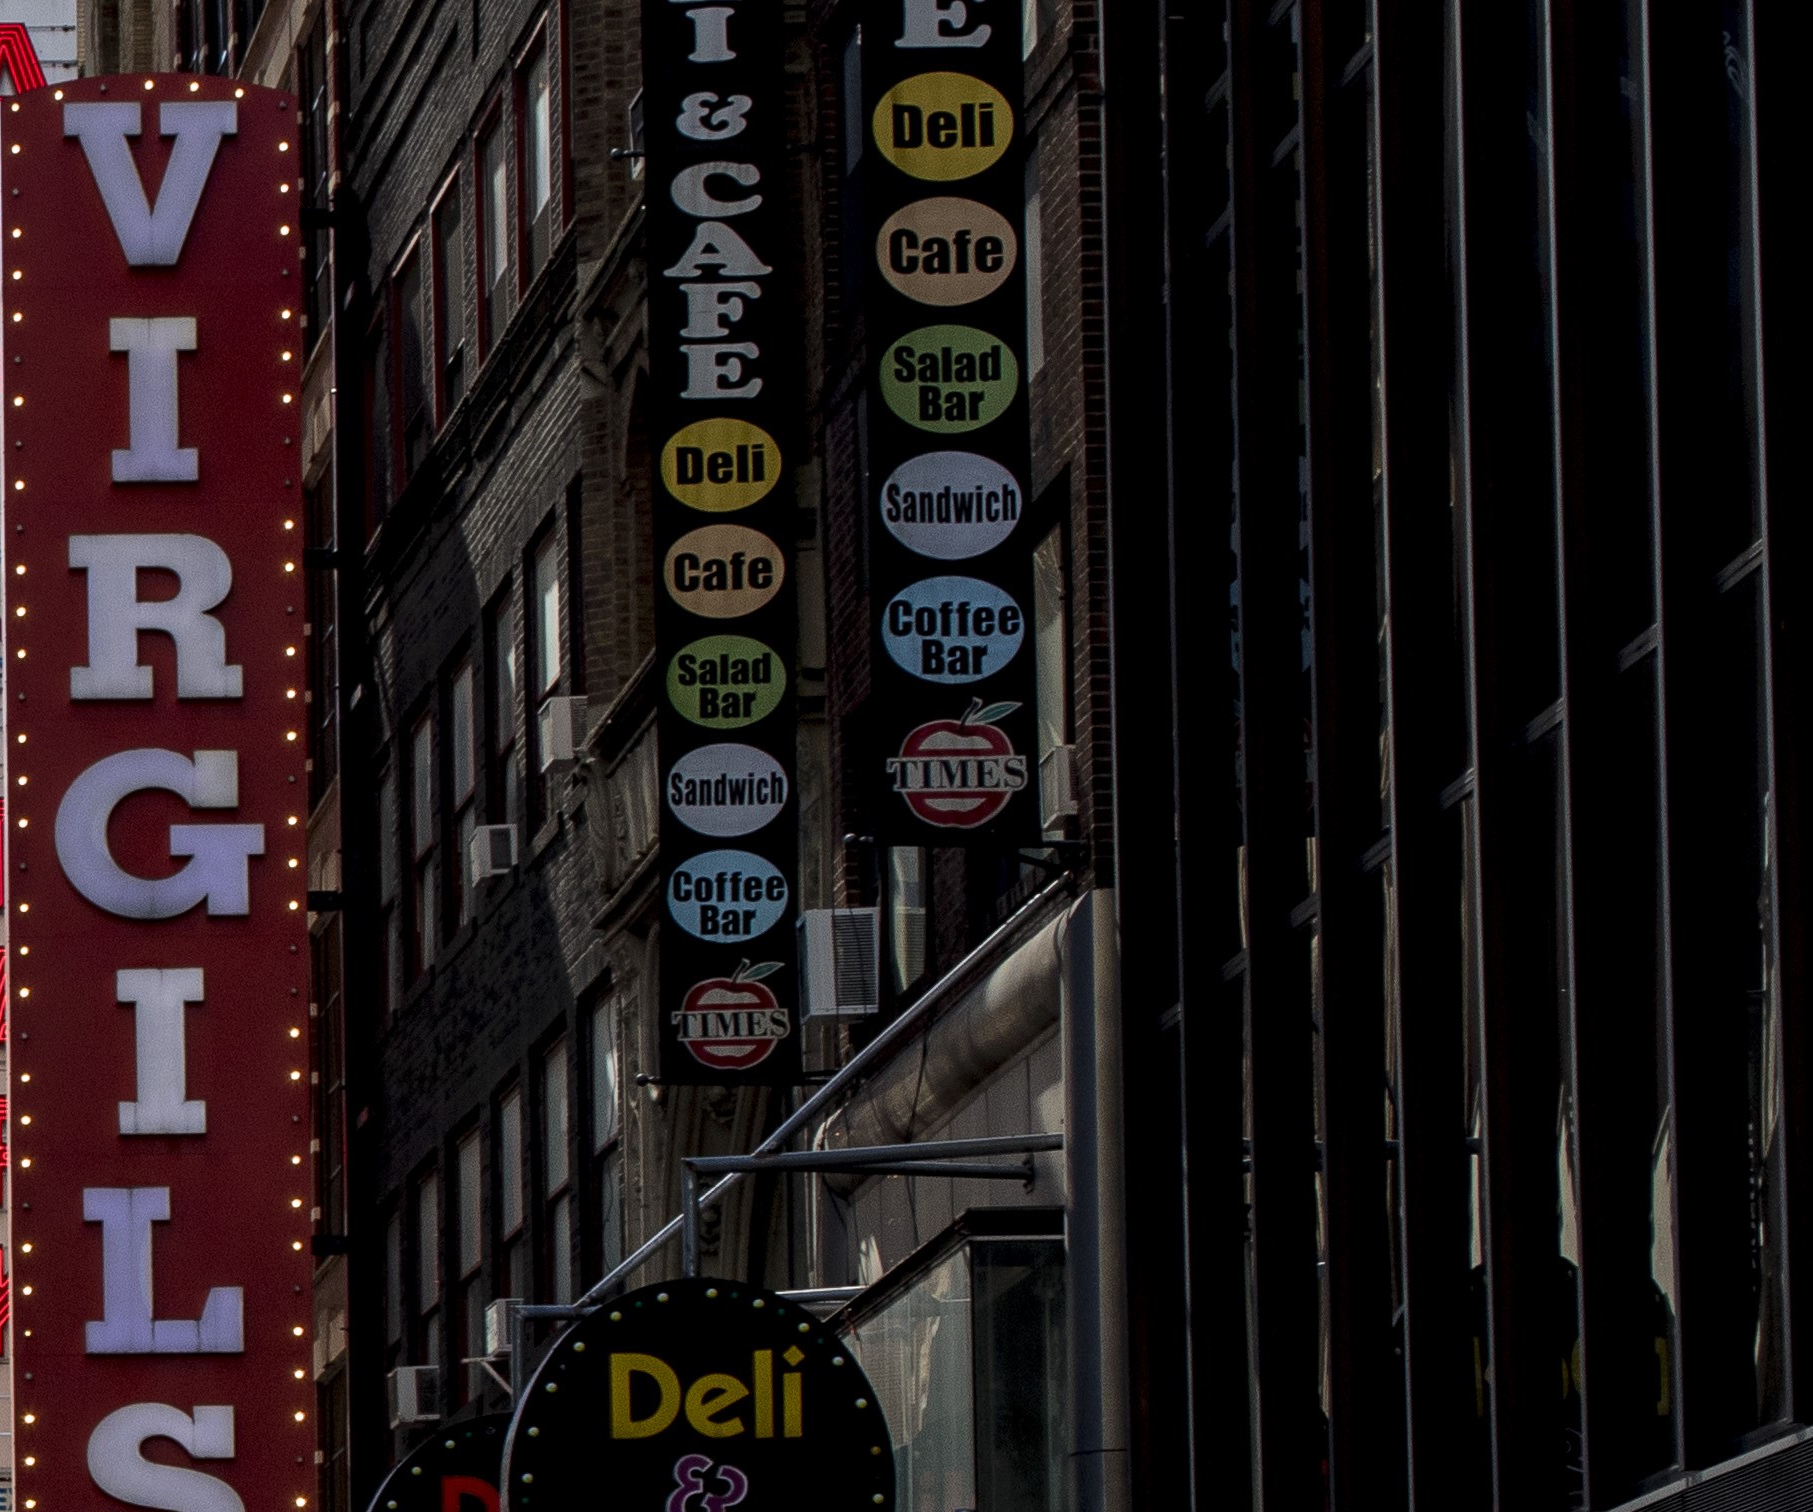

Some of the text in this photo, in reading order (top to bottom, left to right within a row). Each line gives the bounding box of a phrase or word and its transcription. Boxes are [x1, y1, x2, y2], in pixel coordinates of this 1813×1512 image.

[892, 102, 994, 149] Deli
[889, 228, 1005, 275] Cafe
[663, 162, 773, 400] CAFE
[893, 345, 1001, 384] Salad
[919, 386, 985, 422] Bar
[676, 443, 766, 485] Deli
[885, 484, 1018, 524] Sandwich
[673, 552, 773, 592] Cafe
[889, 600, 1021, 637] Coffee
[677, 652, 771, 686] Salad
[921, 638, 988, 675] Bar
[699, 687, 756, 719] Bar
[671, 772, 784, 806] Sandwich
[888, 756, 1029, 791] TIMES
[673, 872, 785, 903] Coffee
[700, 905, 756, 936] Bar
[677, 1008, 790, 1039] TIMES
[609, 1345, 805, 1440] Deli
